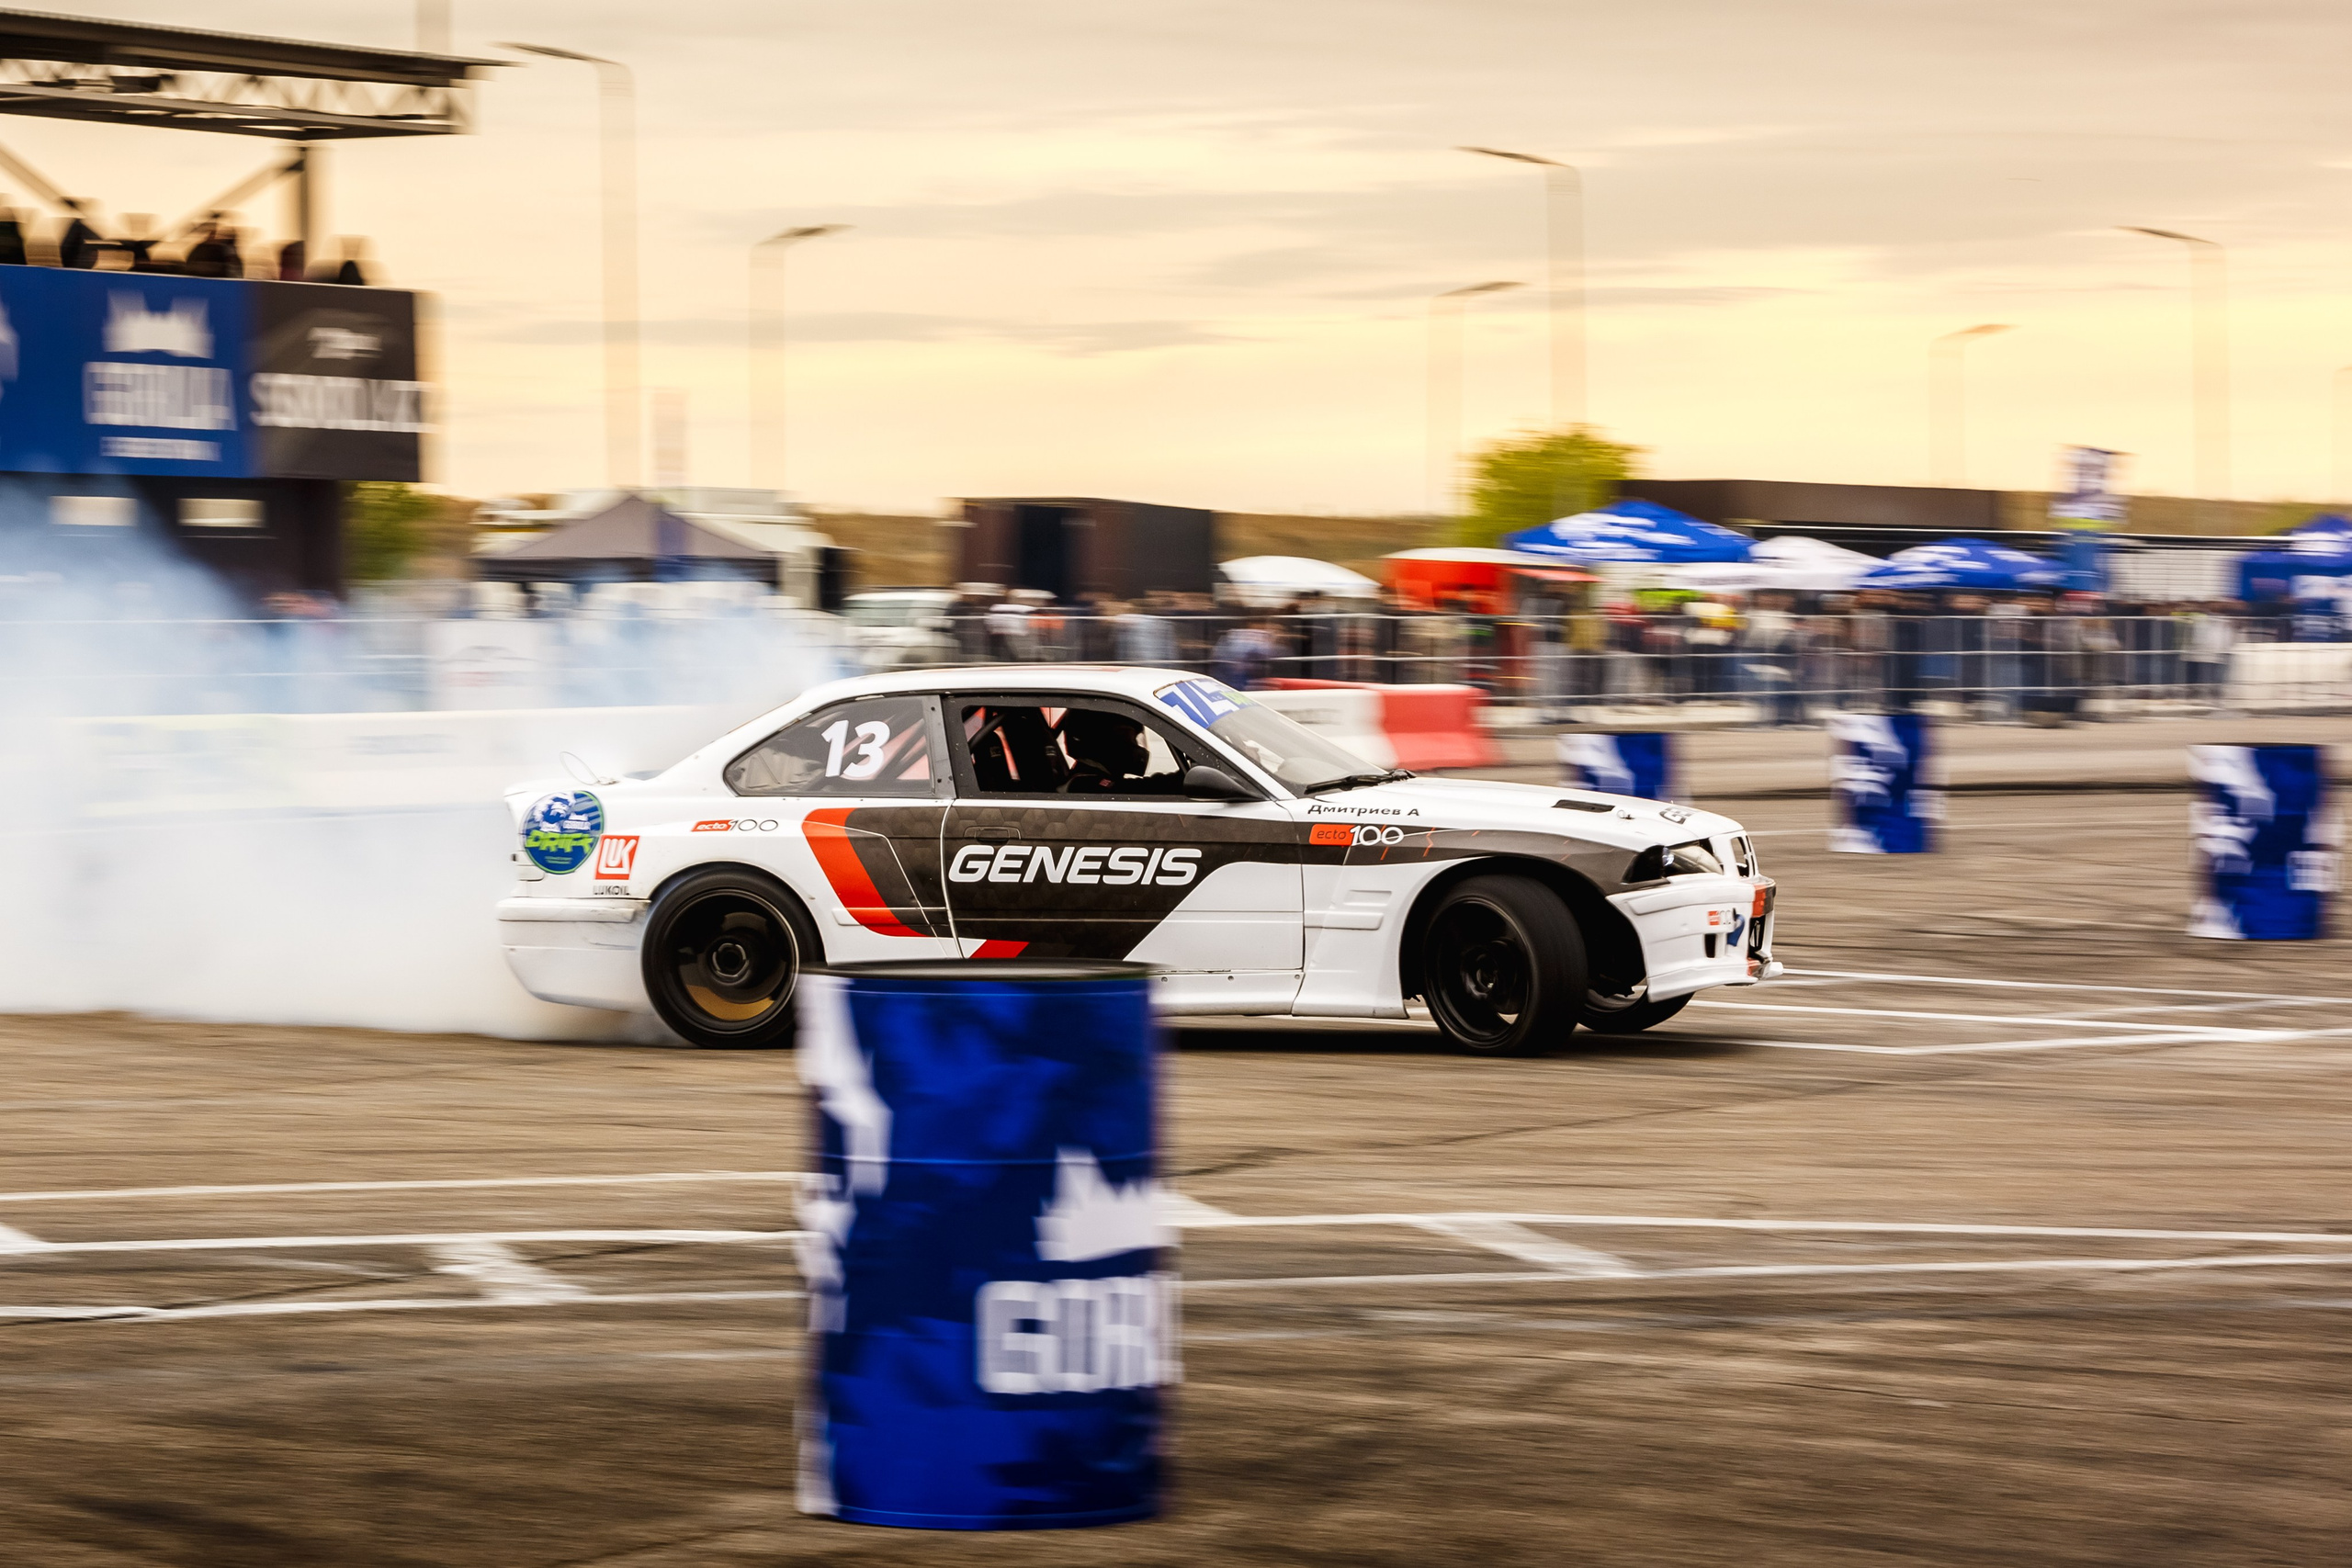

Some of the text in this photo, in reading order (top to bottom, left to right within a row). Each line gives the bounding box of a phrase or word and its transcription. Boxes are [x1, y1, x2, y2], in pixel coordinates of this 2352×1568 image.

[821, 720, 890, 777] 13
[1307, 805, 1401, 817] Дмитриев
[948, 844, 1203, 886] GENESIS
[593, 886, 630, 896] LUKOIL
